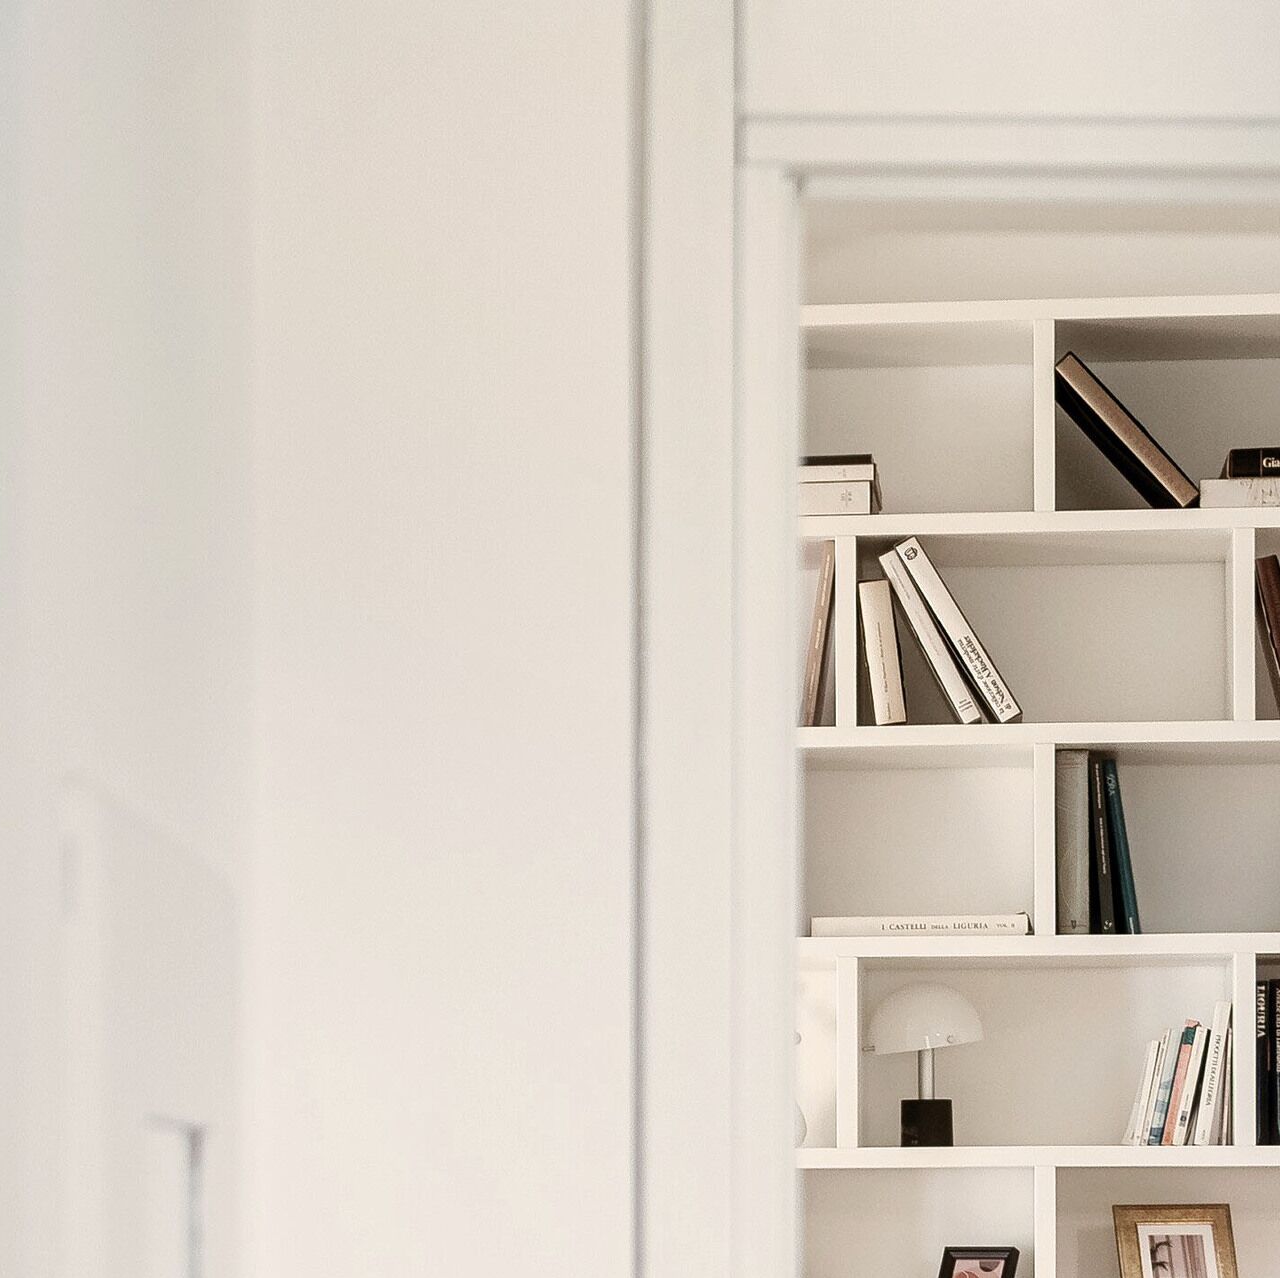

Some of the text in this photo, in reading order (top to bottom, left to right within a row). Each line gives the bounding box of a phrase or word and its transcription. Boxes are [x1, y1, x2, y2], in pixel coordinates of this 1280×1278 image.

[957, 639, 972, 664] moderna
[965, 635, 989, 673] Rockefeller
[990, 679, 1006, 704] Nelson
[997, 706, 1005, 715] la
[1003, 702, 1012, 711] di
[888, 922, 927, 930] CASTELLI
[952, 921, 989, 929] LIGURIA
[1257, 985, 1266, 1038] LIGURIA
